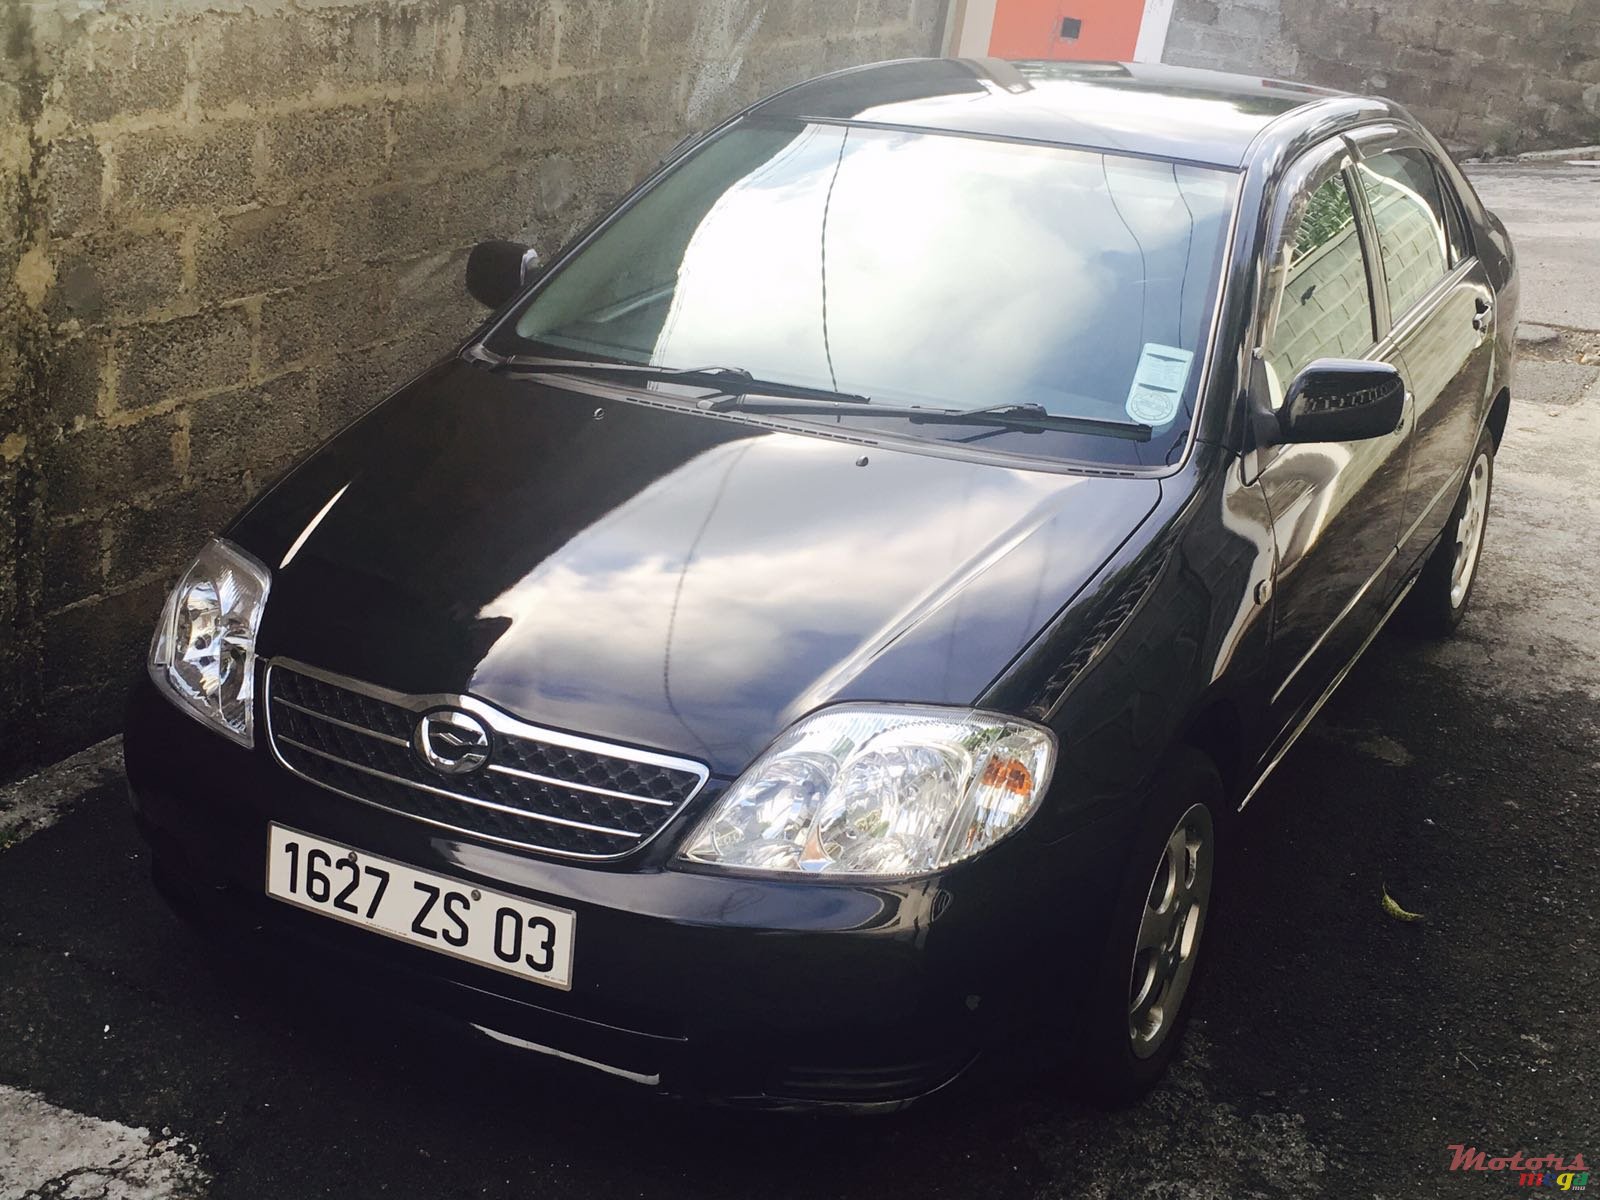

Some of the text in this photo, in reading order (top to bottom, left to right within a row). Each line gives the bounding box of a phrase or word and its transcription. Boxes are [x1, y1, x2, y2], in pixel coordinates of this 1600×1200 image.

[285, 842, 556, 972] 1627 ZS 03
